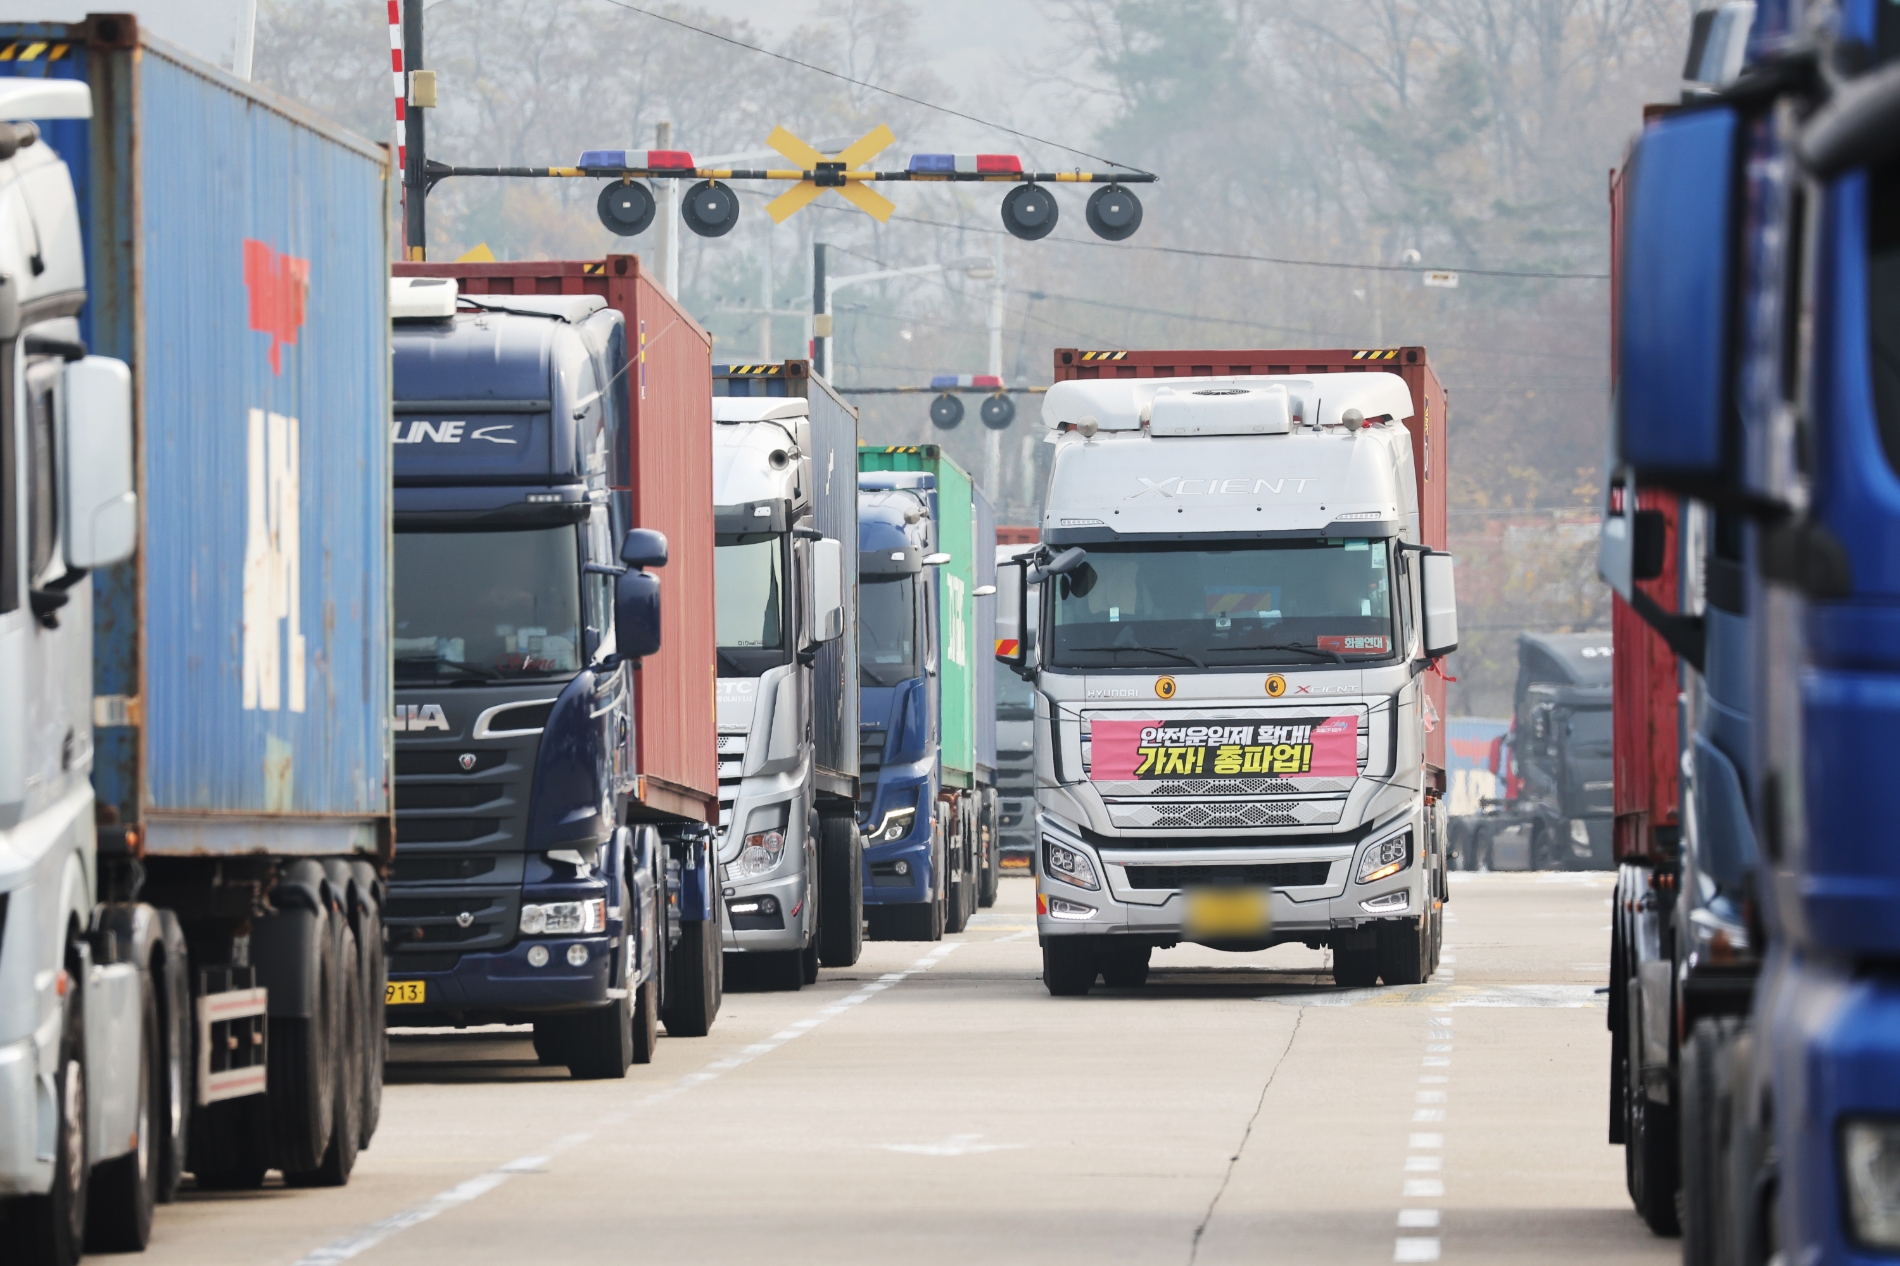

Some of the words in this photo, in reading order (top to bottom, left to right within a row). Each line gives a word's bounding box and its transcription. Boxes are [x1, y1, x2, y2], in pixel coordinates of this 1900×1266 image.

[1124, 476, 1319, 500] XCIENT
[1344, 637, 1383, 649] 화물연대
[1087, 689, 1139, 698] HYUNDAI
[1294, 685, 1359, 694] XCIENT
[1140, 725, 1255, 747] 안전운임제
[1257, 724, 1312, 746] 확대!
[1135, 746, 1206, 775] 가자!
[1213, 744, 1313, 775] 총파업!
[387, 985, 418, 1001] 913
